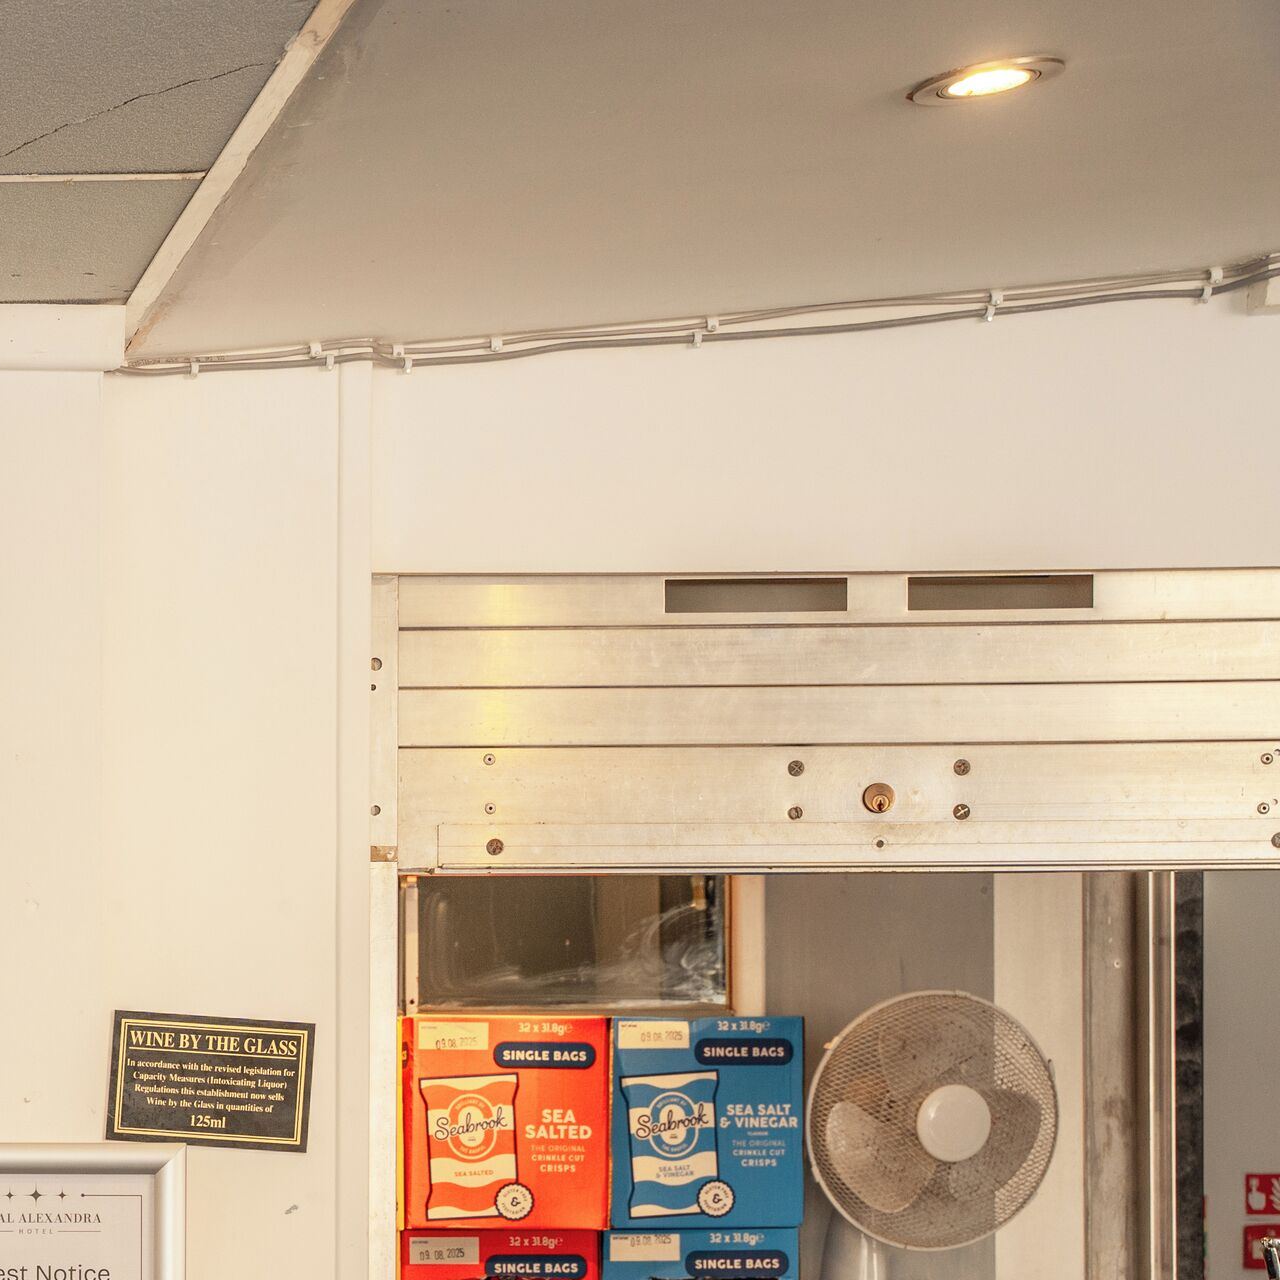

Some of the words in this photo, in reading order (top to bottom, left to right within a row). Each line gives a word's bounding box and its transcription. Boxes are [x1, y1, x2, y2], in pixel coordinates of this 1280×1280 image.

[130, 1031, 175, 1048] WINE
[179, 1035, 203, 1049] BY
[206, 1036, 240, 1051] THE
[244, 1038, 297, 1055] GLASS
[503, 1050, 550, 1061] SINGLE
[554, 1051, 587, 1061] BAGS
[704, 1047, 748, 1057] SINGLE
[752, 1047, 785, 1057] BAGS
[127, 1058, 136, 1066] In
[136, 1059, 180, 1070] accordance
[182, 1061, 199, 1071] with
[200, 1063, 213, 1072] the
[215, 1064, 241, 1073] revised
[243, 1066, 282, 1076] legislation
[283, 1069, 295, 1077] for
[133, 1072, 167, 1082] Capacity
[169, 1074, 205, 1083] Measures
[207, 1076, 256, 1088] (Intoxicating
[258, 1079, 287, 1089] Liquor)
[135, 1084, 179, 1094] Regulations
[181, 1087, 195, 1095] this
[197, 1088, 249, 1099] establishment
[268, 1092, 285, 1101] sells
[146, 1097, 167, 1105] Wine
[168, 1099, 178, 1108] by
[180, 1099, 192, 1107] the
[194, 1100, 215, 1109] Glass
[216, 1102, 224, 1110] in
[225, 1103, 263, 1113] quantities
[265, 1105, 273, 1113] of
[727, 1104, 755, 1115] SEA
[758, 1104, 791, 1115] SALT
[190, 1115, 226, 1128] 125ml
[541, 1109, 576, 1123] SEA
[636, 1103, 709, 1138] Seabrook
[720, 1117, 731, 1128] &
[735, 1117, 798, 1128] VINEGAR
[434, 1107, 508, 1140] Seabrook
[525, 1125, 592, 1139] SALTED
[540, 1164, 576, 1172] CRISPS
[741, 1159, 777, 1167] CRISPS
[19, 1213, 101, 1224] ALEXANDRA
[494, 1263, 540, 1273] SINGLE
[545, 1263, 578, 1273] BAGS
[695, 1260, 741, 1269] SINGLE
[745, 1259, 780, 1269] BAGS
